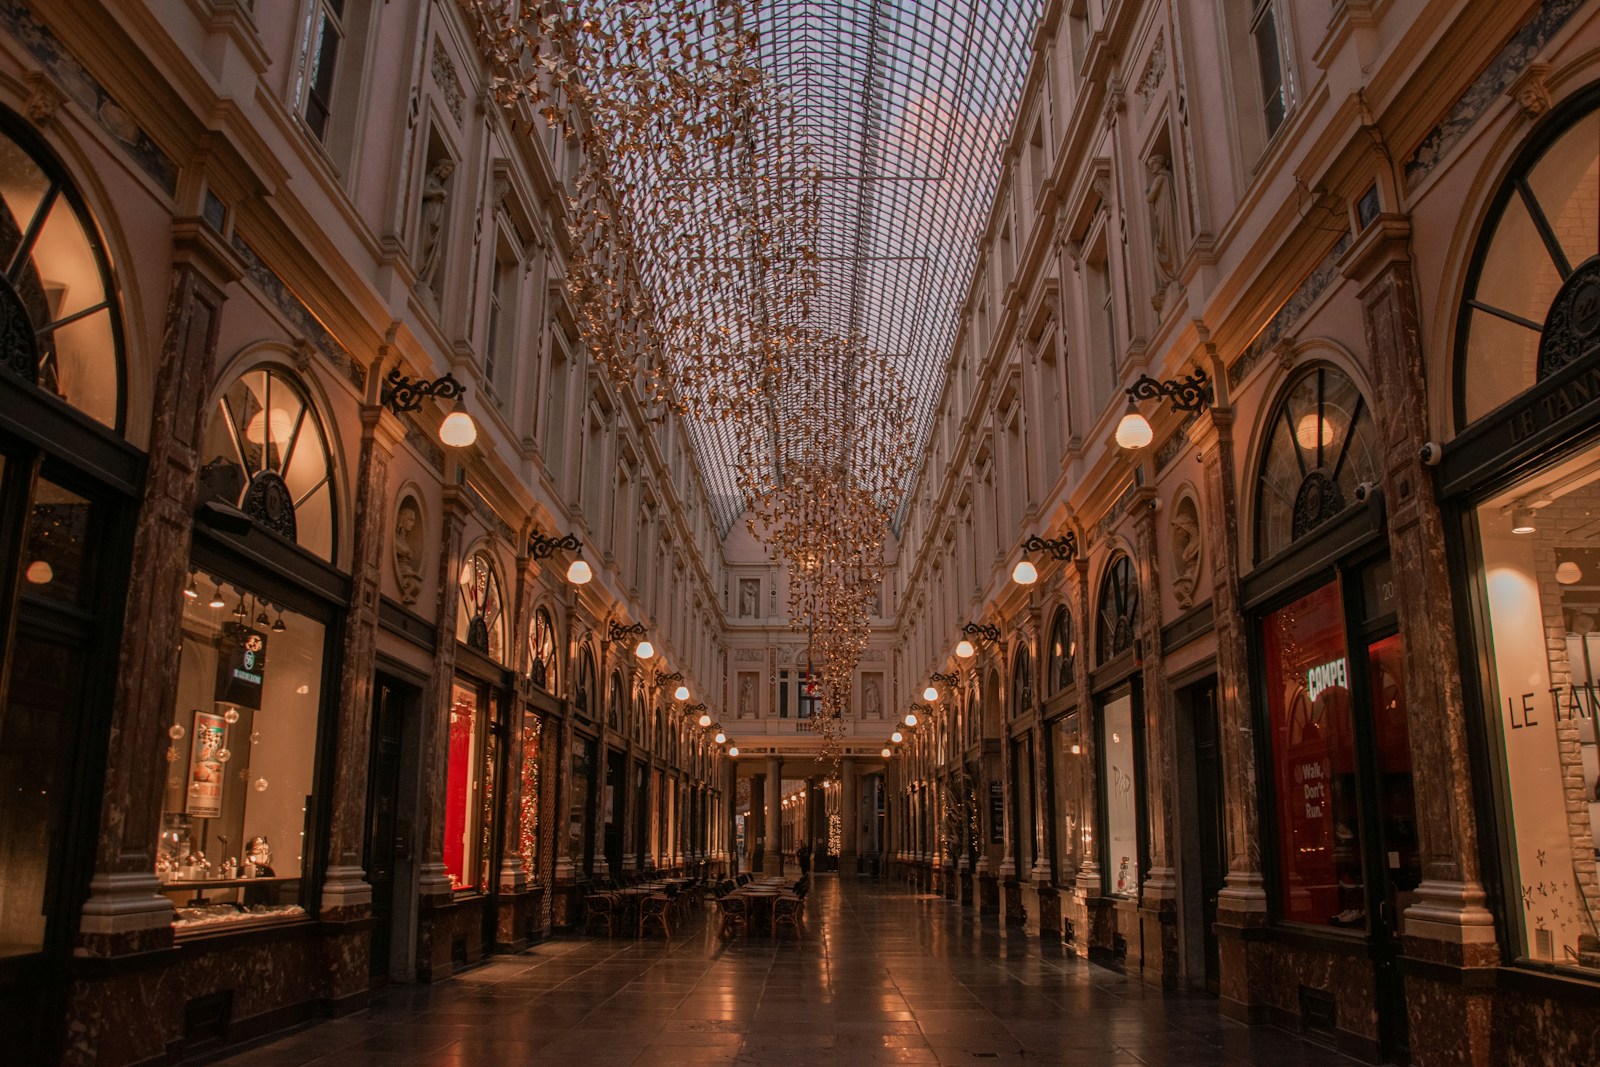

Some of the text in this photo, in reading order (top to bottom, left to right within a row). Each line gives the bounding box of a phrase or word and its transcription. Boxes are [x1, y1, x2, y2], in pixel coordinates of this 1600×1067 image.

[1507, 407, 1535, 444] LE
[1508, 693, 1538, 730] LE
[1302, 762, 1324, 780] Walk,
[1304, 782, 1325, 800] Don't
[1305, 803, 1323, 819] Run.
